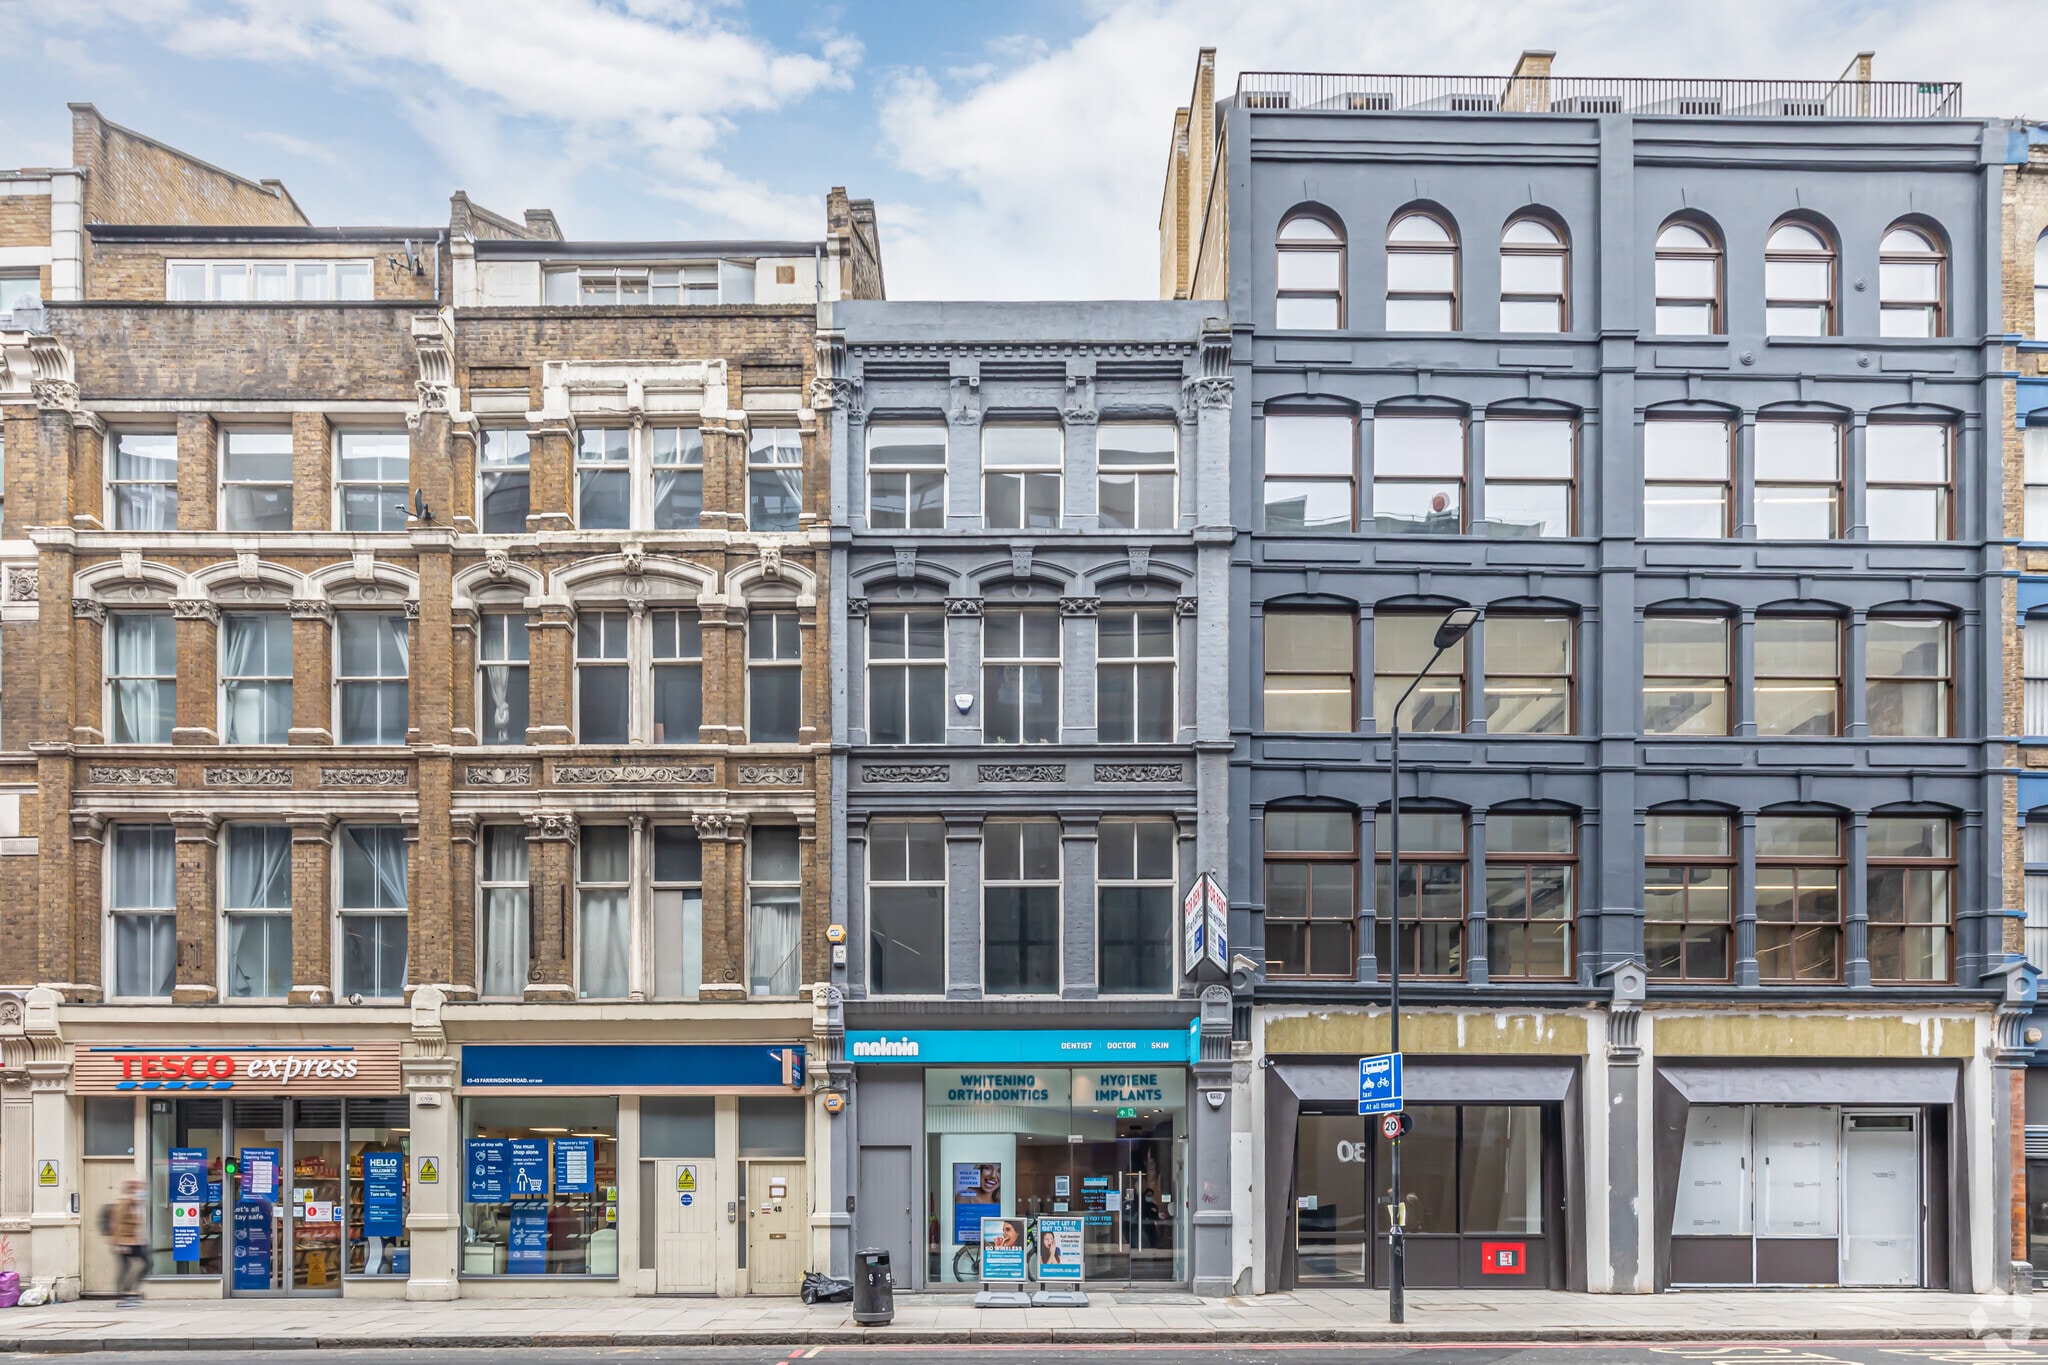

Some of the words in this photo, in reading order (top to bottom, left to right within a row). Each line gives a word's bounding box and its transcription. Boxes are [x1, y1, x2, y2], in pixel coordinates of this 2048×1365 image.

[853, 1037, 919, 1056] malmin
[114, 1055, 235, 1079] TESCO
[247, 1055, 358, 1085] express
[961, 1075, 1035, 1087] WHITENING
[1101, 1074, 1157, 1086] HYGIENE
[948, 1089, 1048, 1101] ORTHODONTICS
[1095, 1089, 1162, 1101] IMPLANTS
[1385, 1121, 1397, 1131] 20
[369, 1159, 397, 1167] HELLO
